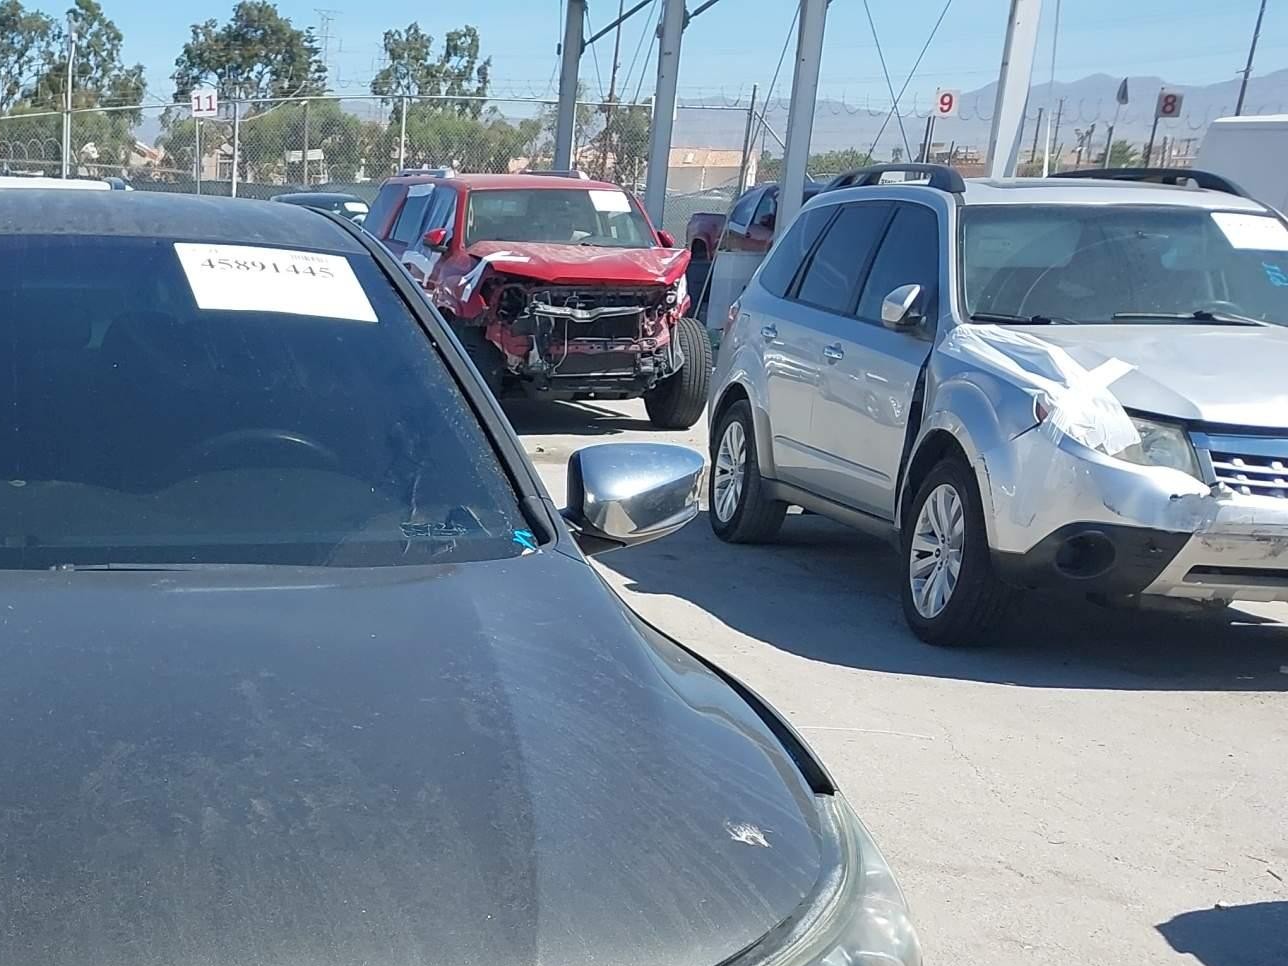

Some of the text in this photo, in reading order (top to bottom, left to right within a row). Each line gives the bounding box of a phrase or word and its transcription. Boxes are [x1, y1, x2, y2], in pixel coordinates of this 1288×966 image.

[193, 95, 216, 112] 11
[939, 93, 953, 113] 9
[1162, 94, 1176, 114] 8
[200, 258, 335, 278] 45891445
